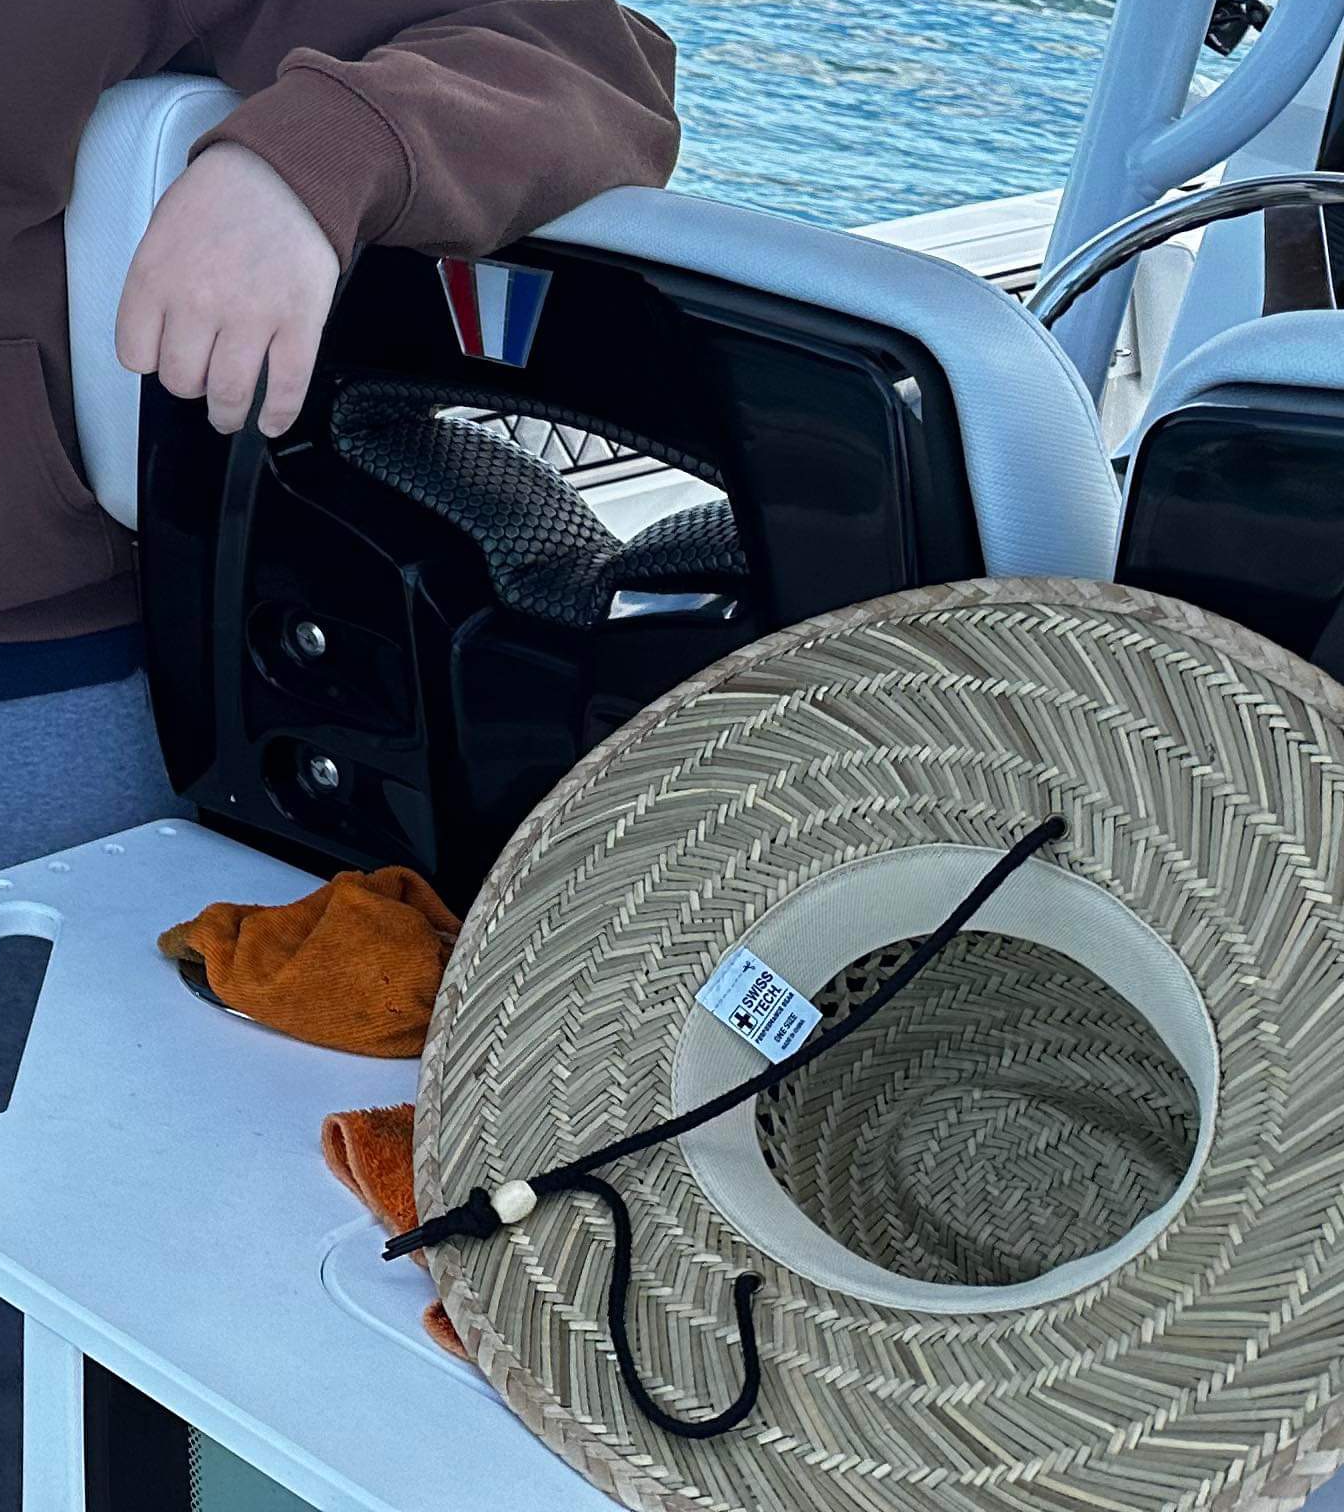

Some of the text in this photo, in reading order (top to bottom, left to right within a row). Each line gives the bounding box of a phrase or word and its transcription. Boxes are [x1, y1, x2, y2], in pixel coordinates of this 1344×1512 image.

[742, 971, 774, 1008] SWISS
[774, 1012, 798, 1043] ONE SIZE
